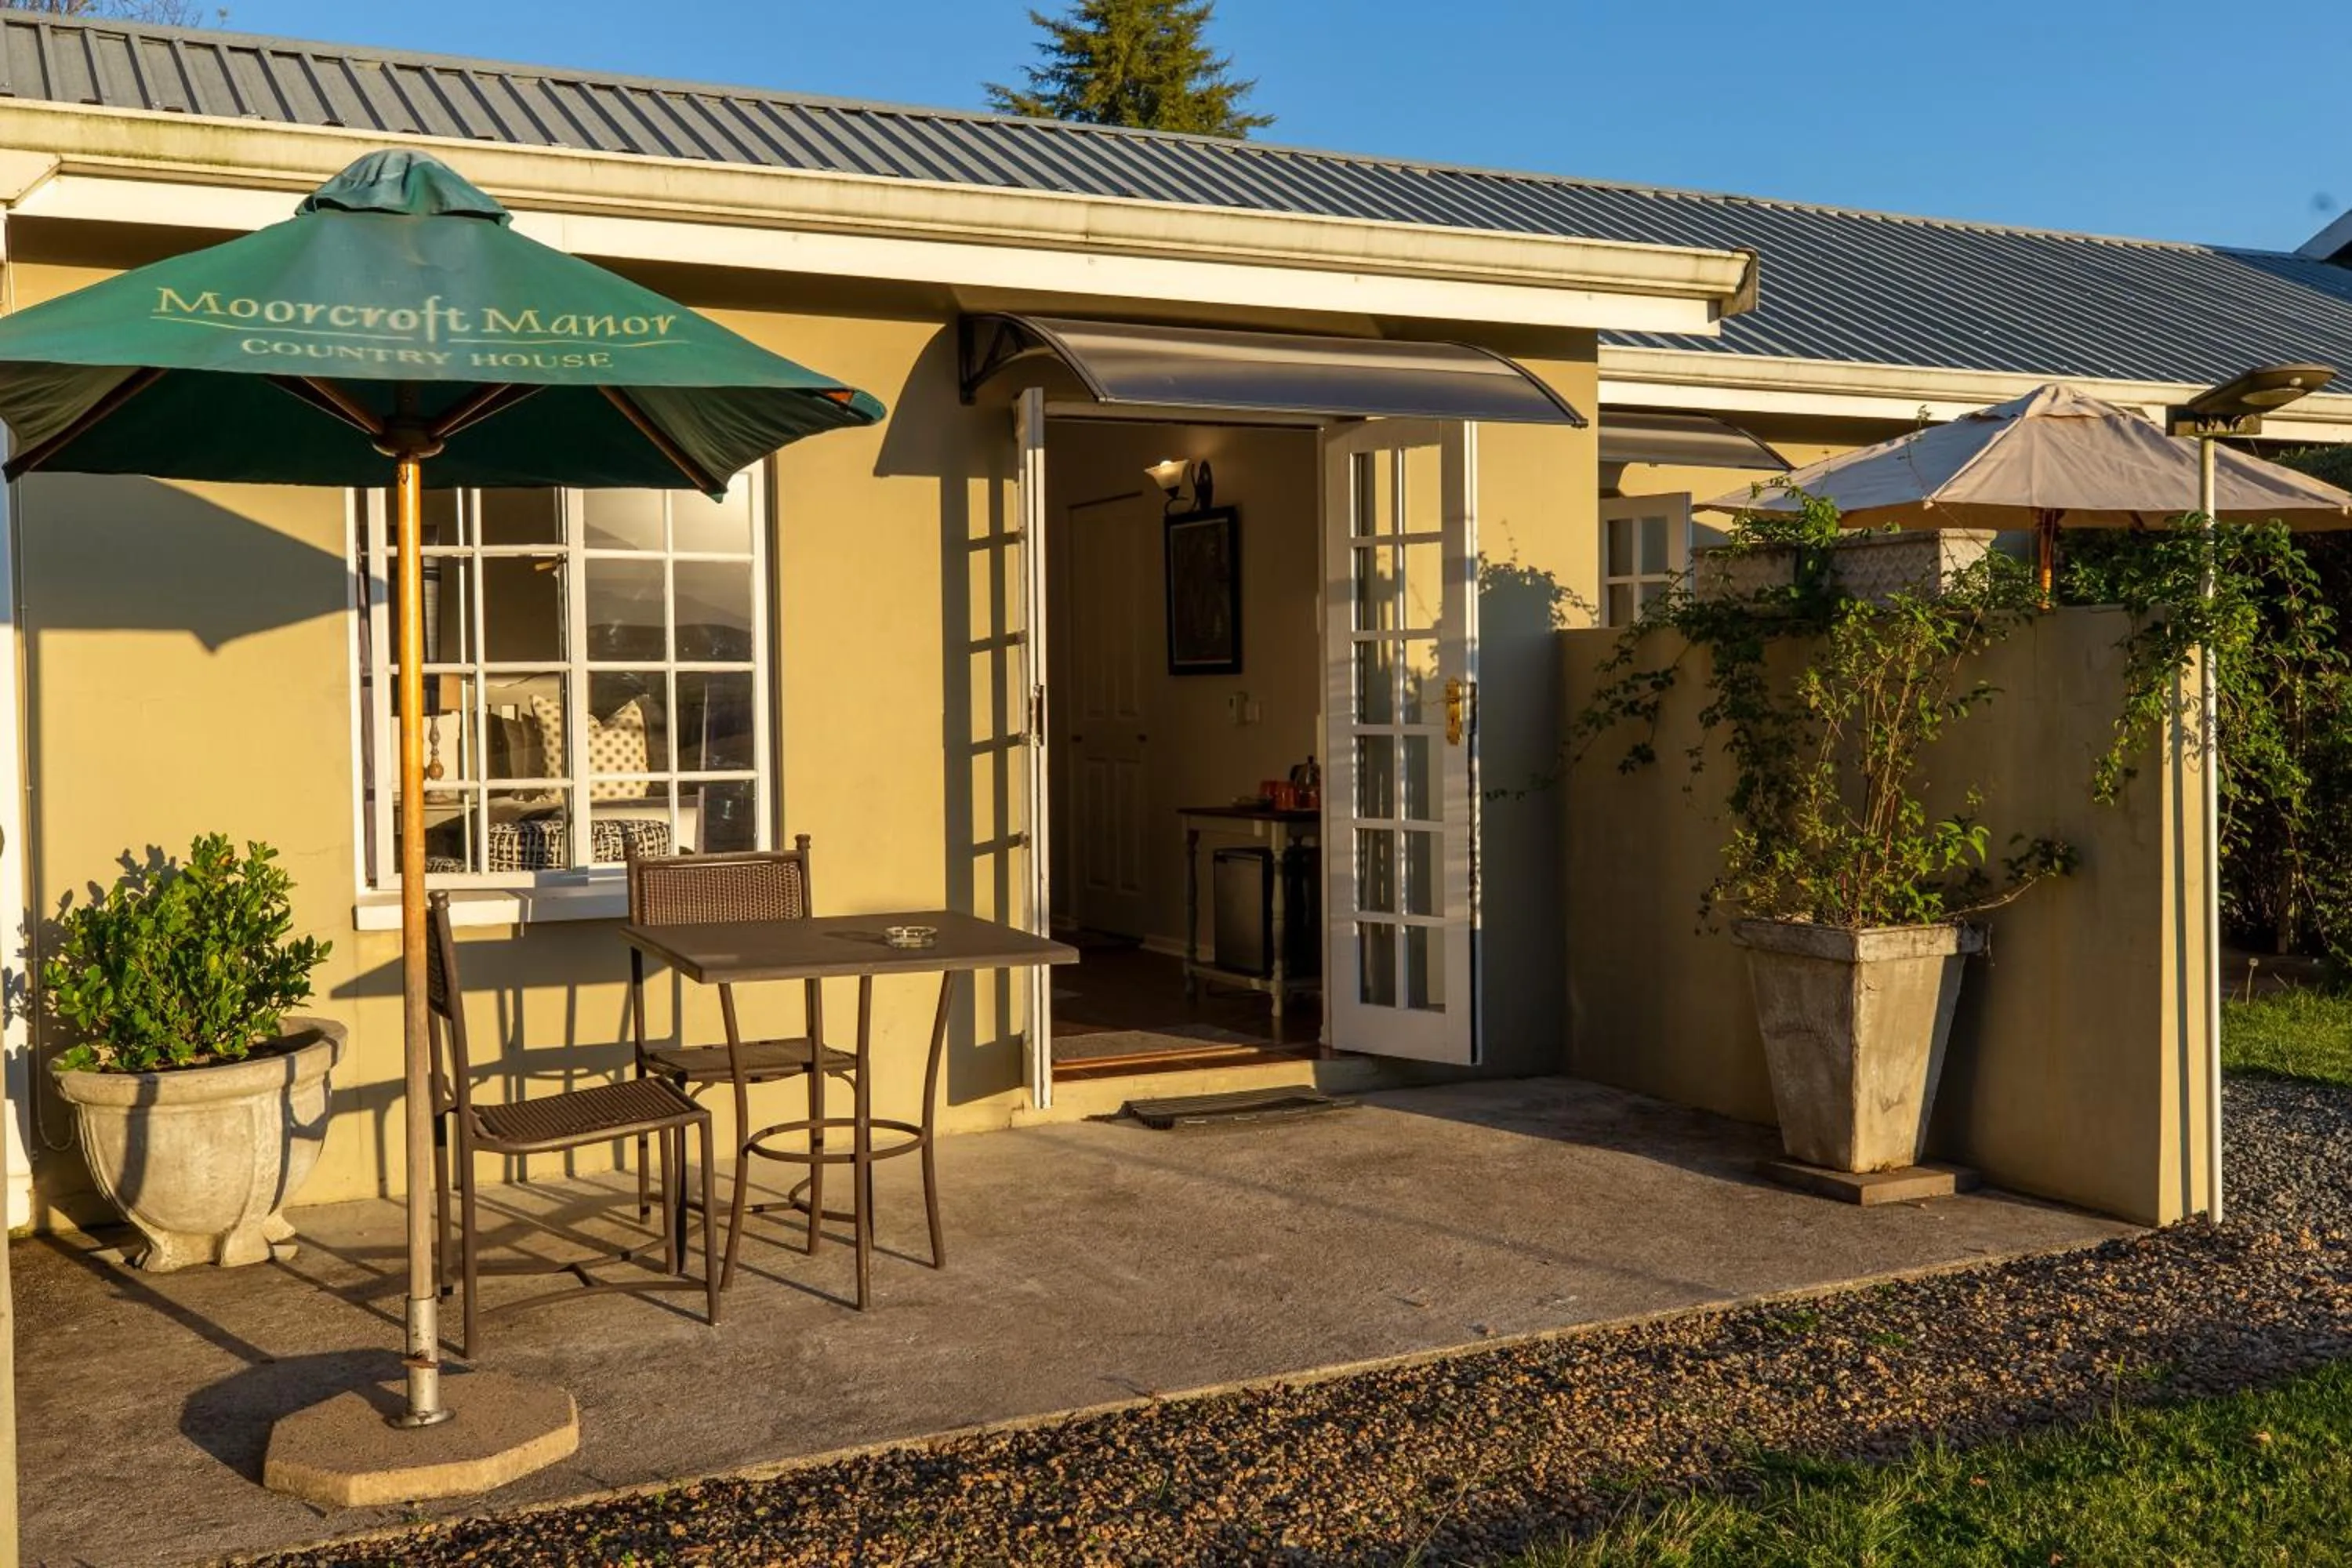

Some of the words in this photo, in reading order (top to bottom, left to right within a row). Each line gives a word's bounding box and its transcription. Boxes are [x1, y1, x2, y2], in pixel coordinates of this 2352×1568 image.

[152, 287, 472, 343] Moorcroft
[481, 307, 677, 336] Manor
[241, 338, 452, 365] COUNTRY
[471, 352, 614, 368] HOUSE
